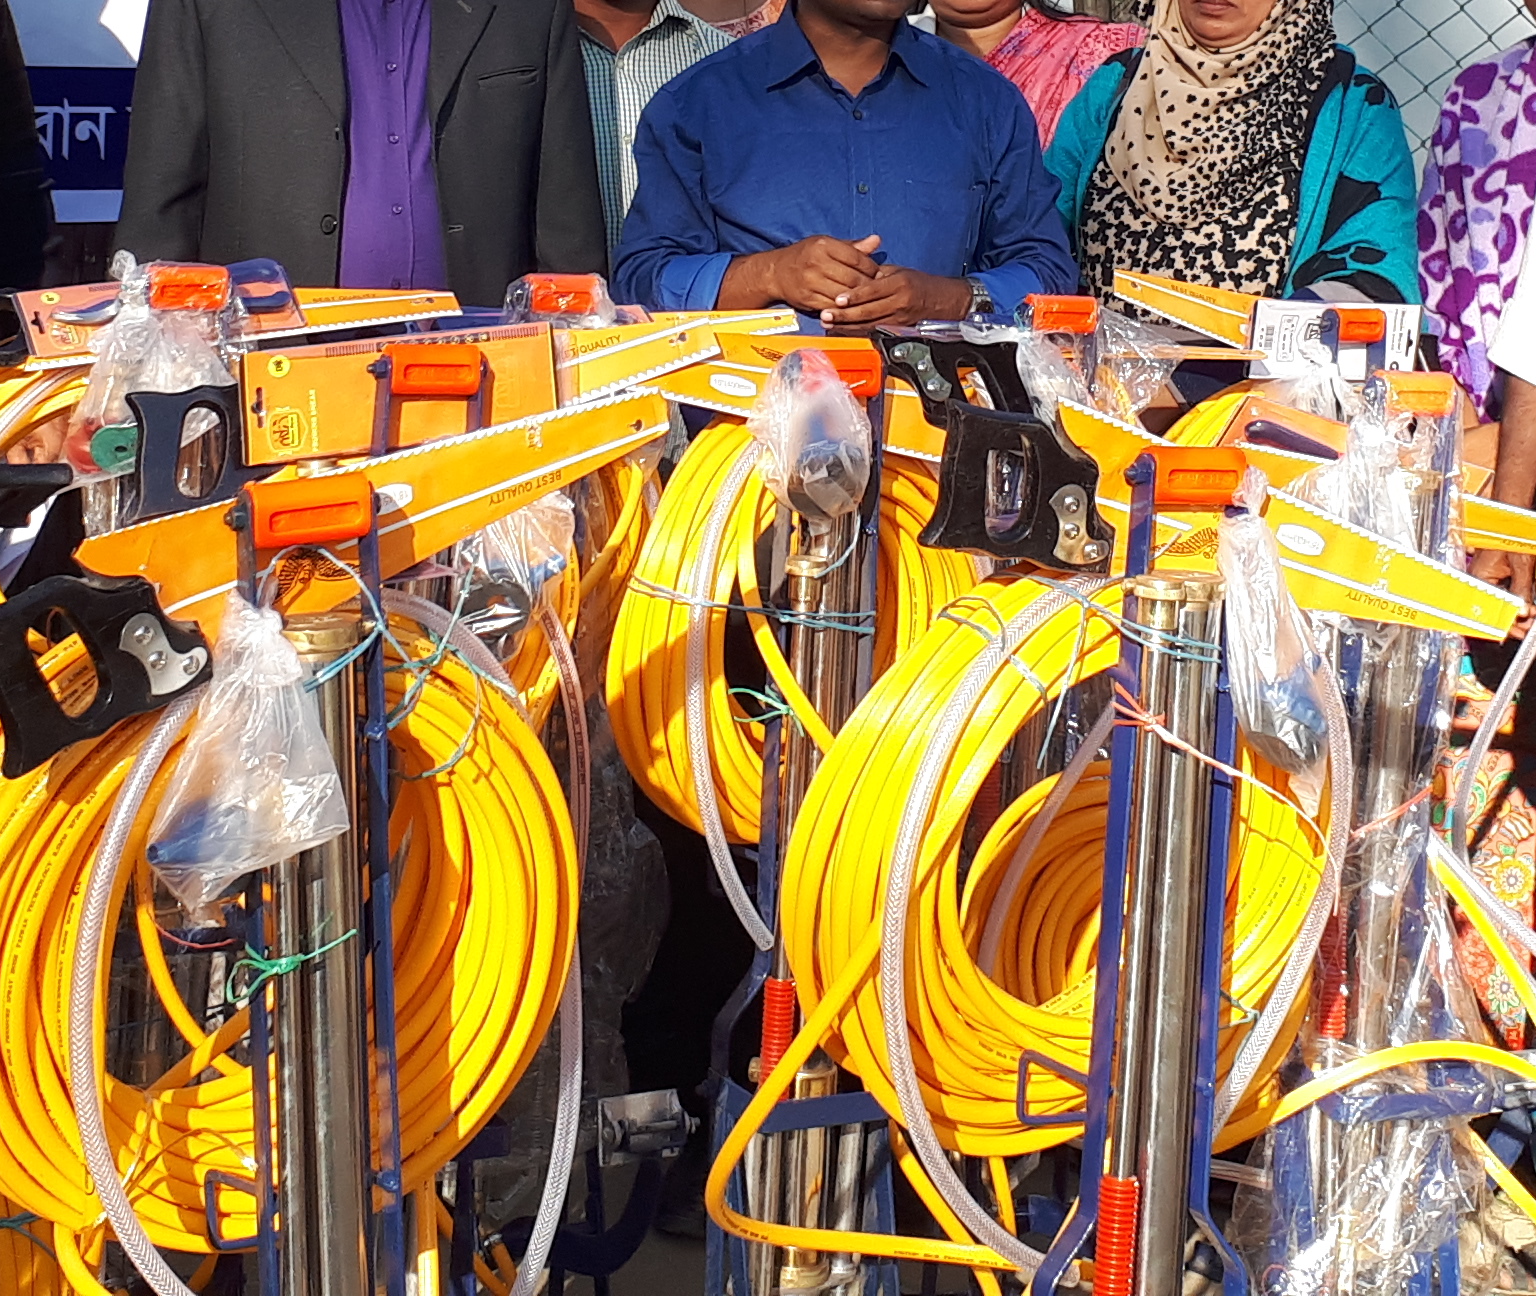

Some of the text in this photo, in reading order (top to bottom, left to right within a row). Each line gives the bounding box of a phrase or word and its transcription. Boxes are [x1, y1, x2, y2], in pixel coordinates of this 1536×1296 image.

[579, 334, 622, 355] QUALITY
[488, 469, 563, 506] BEST QUALITY
[1345, 589, 1418, 621] BEST QUALITY
